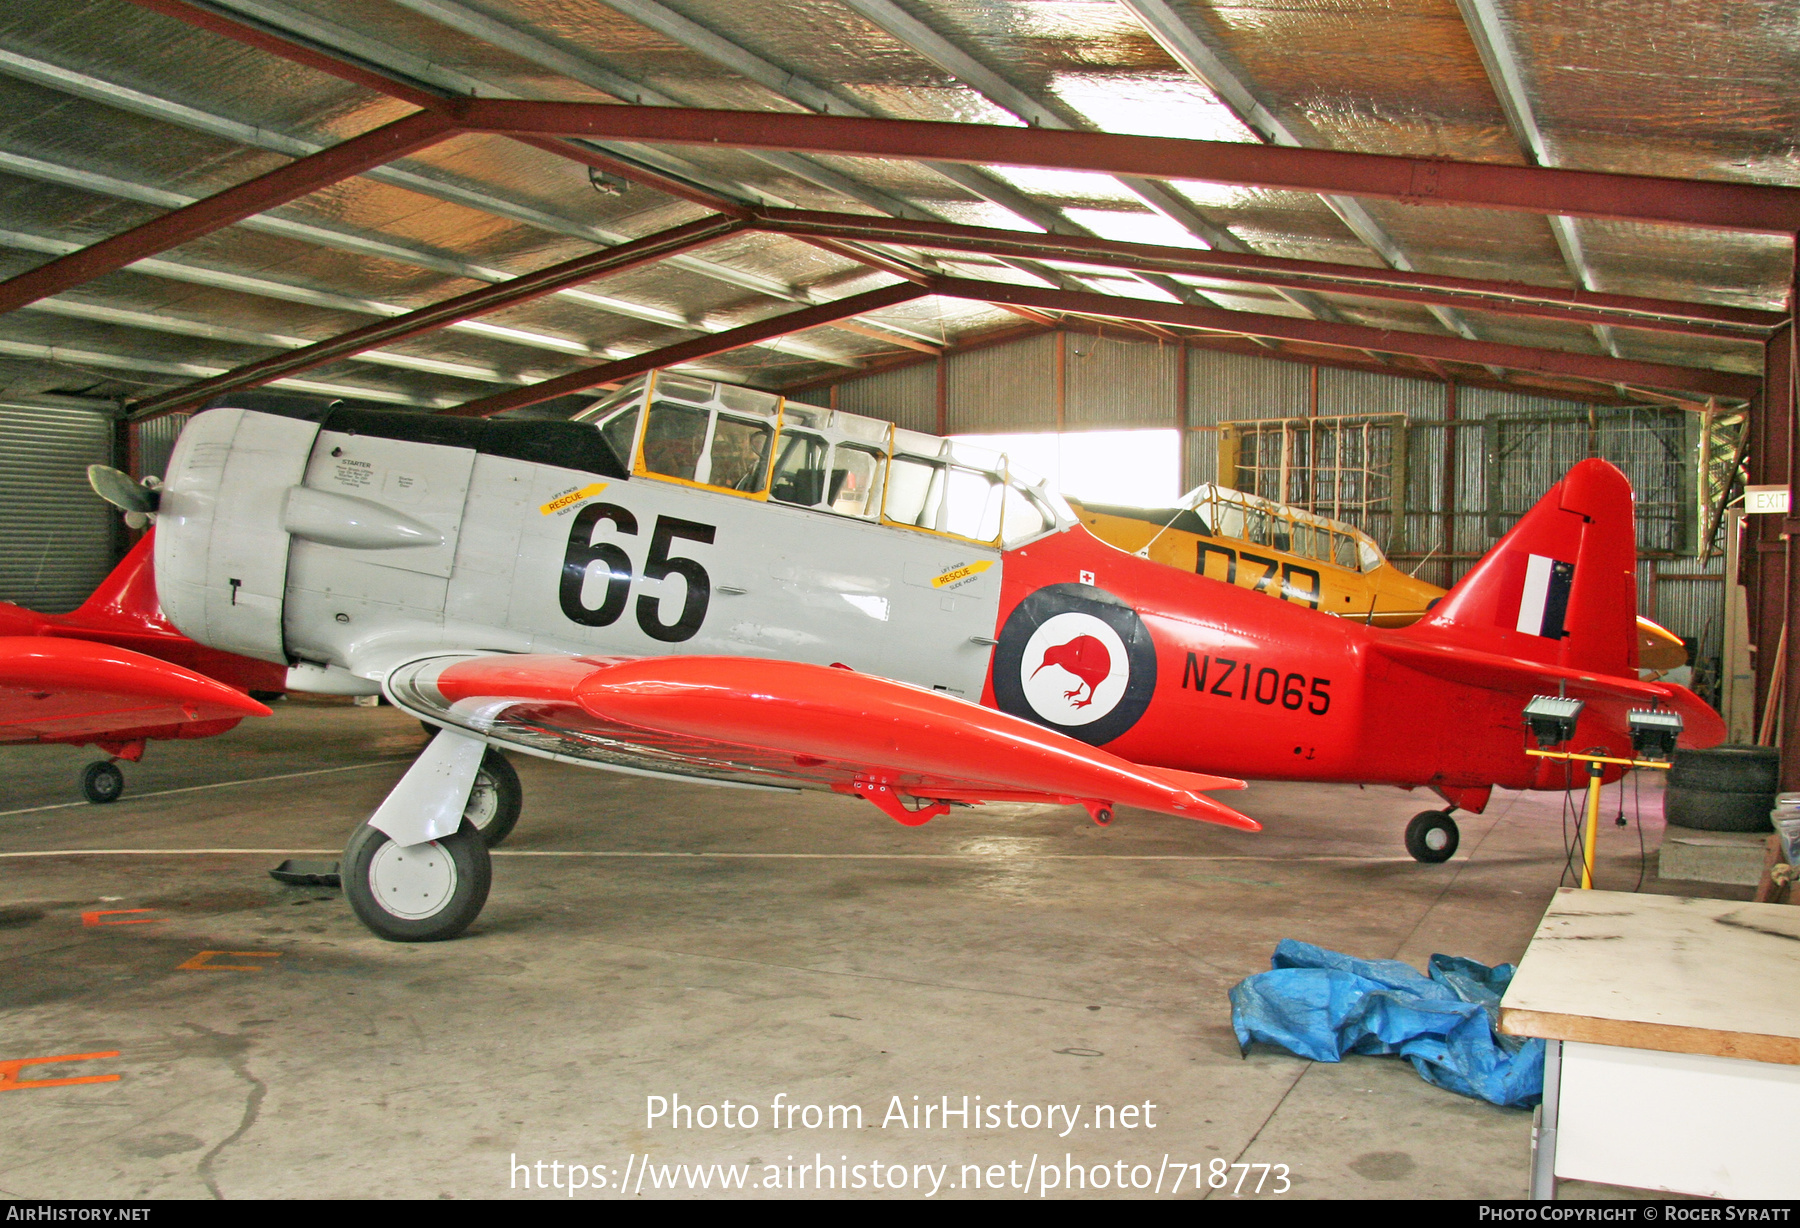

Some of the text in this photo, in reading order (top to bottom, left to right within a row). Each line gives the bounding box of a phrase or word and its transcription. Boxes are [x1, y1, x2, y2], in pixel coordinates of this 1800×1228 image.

[342, 459, 371, 468] STARTER
[548, 492, 583, 511] RESCUE
[1757, 493, 1787, 508] EXIT
[559, 502, 717, 643] 65
[939, 567, 971, 585] RESCUE
[1182, 652, 1331, 715] NZ1065
